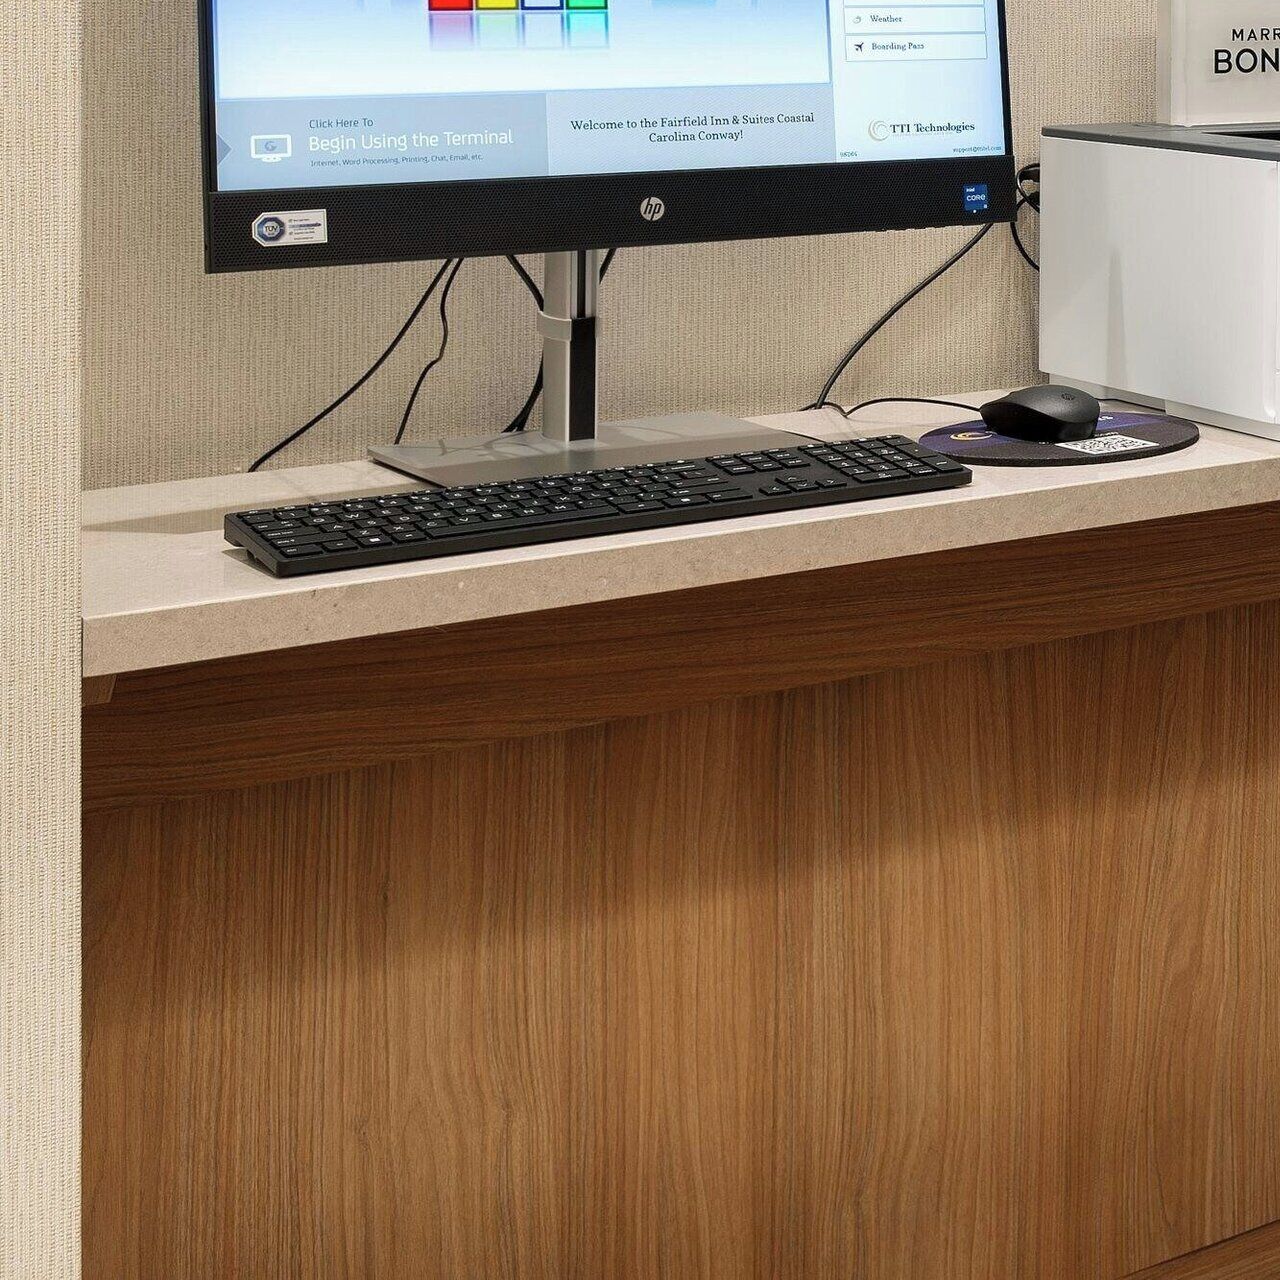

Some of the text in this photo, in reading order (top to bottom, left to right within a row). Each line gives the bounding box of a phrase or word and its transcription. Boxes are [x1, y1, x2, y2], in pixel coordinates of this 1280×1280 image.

[870, 14, 902, 23] Weather
[872, 42, 925, 51] Boarding Pass
[309, 117, 374, 129] Click Here To
[570, 112, 815, 131] Welcome to the Fairfield Inn & Suites Coastal
[890, 122, 976, 134] TTI Technologies
[309, 128, 514, 154] Begin Using the Terminal
[649, 130, 744, 143] Carolina Conway!
[311, 153, 484, 168] Internet, Word Processing, Printing, Chat, Email, etc.
[642, 197, 663, 221] hp
